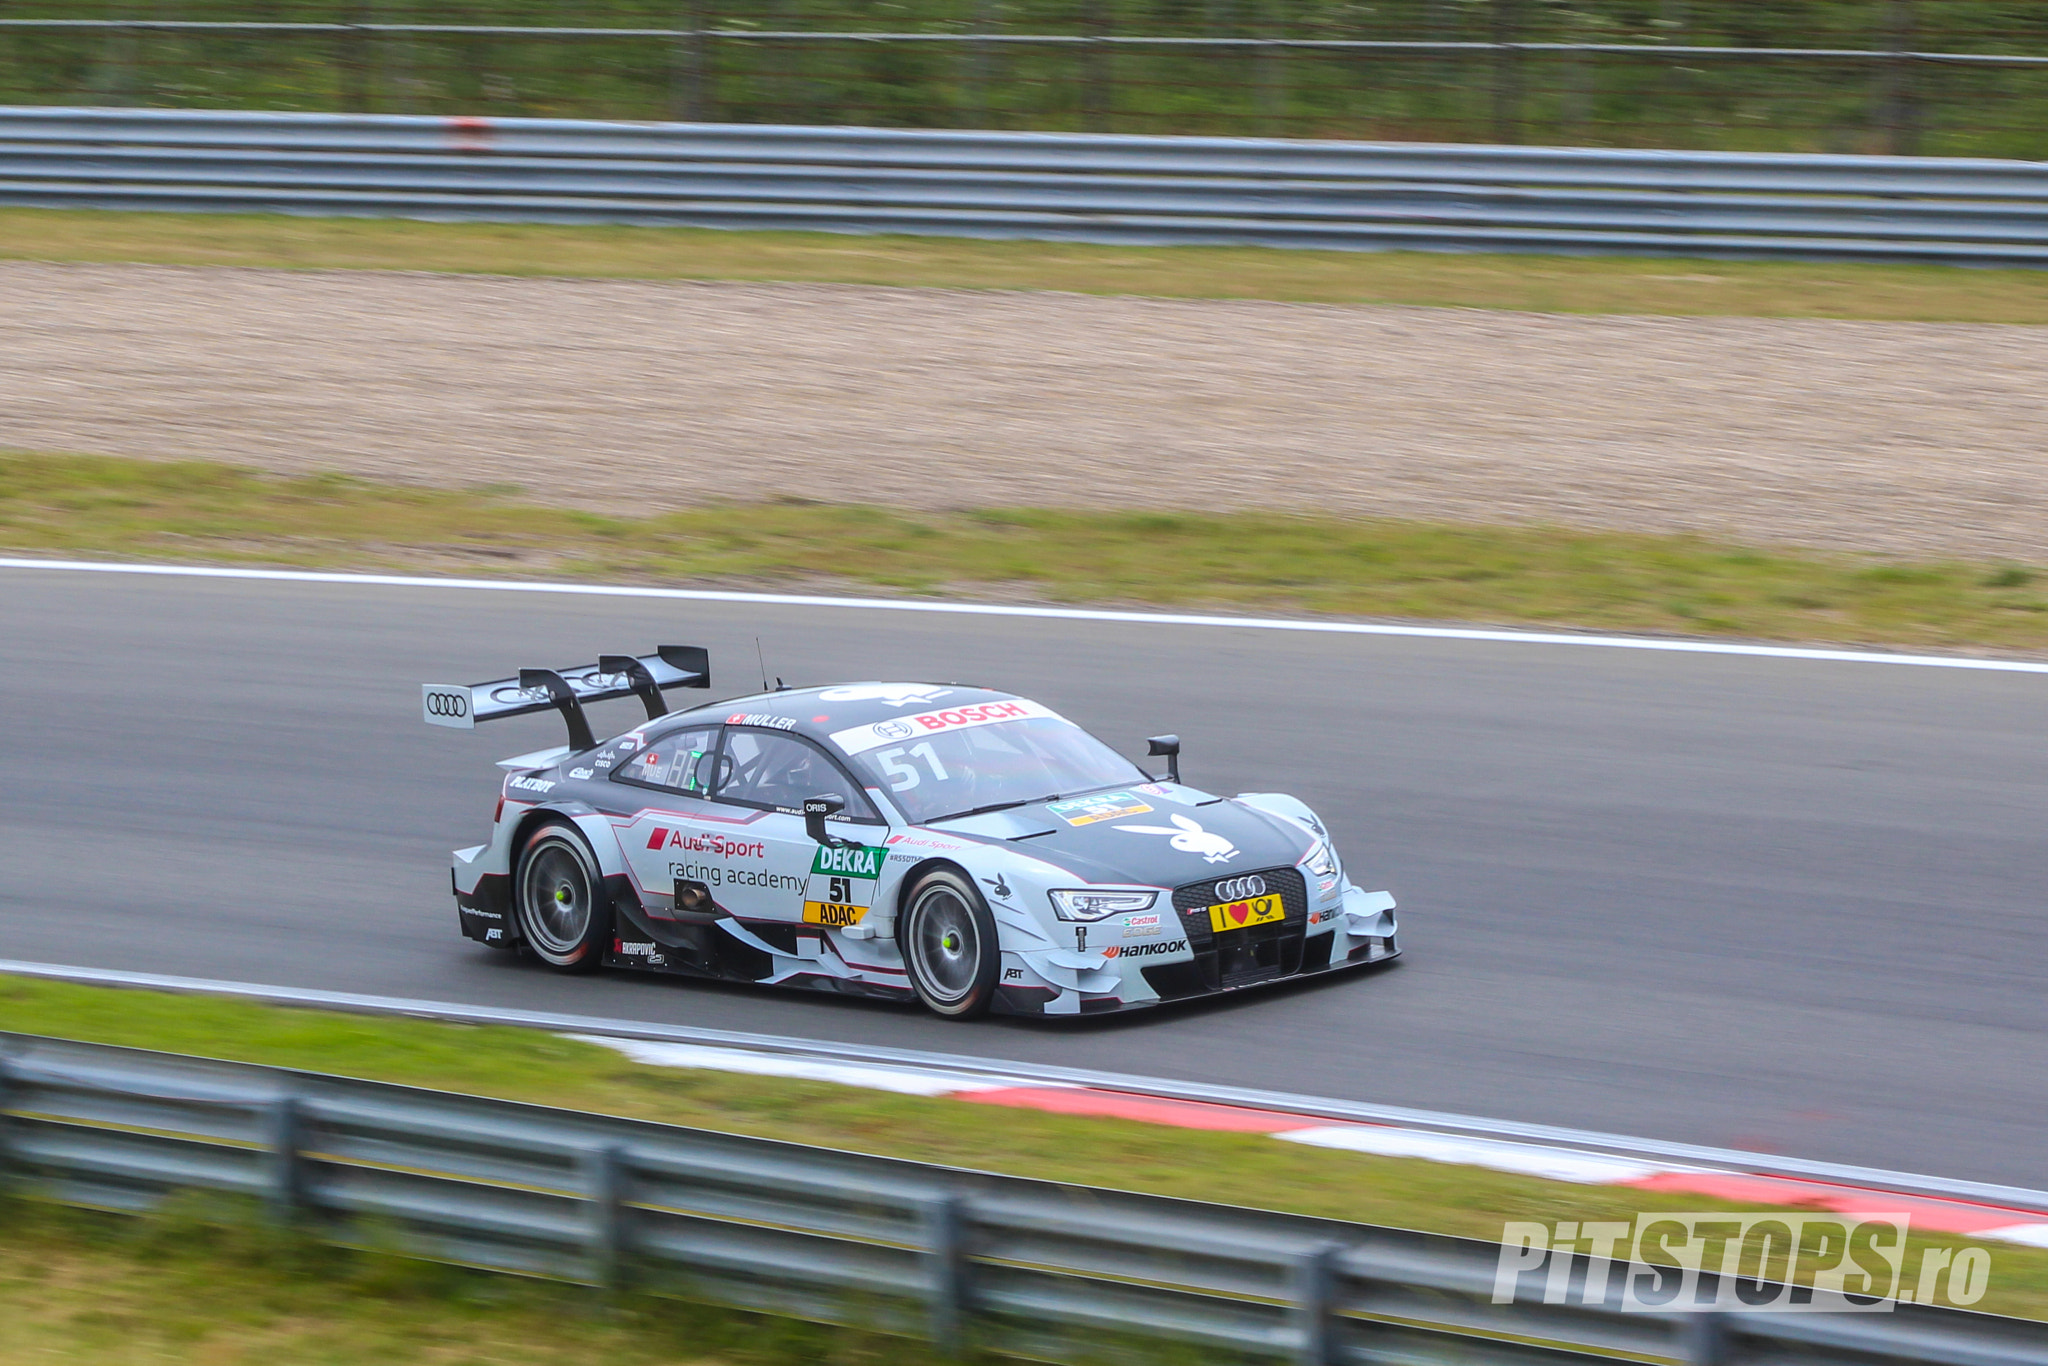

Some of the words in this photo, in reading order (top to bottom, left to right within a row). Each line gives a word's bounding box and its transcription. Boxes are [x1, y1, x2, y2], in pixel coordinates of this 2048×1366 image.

[914, 703, 1029, 730] BOSCH
[875, 742, 949, 792] 51
[509, 775, 556, 793] PLAYBOY
[806, 803, 827, 812] ORIS
[669, 830, 711, 852] Audi
[714, 835, 765, 859] Sport
[820, 847, 877, 875] DEKRA
[668, 860, 721, 887] racing
[727, 868, 808, 896] academy
[829, 877, 852, 903] 51
[820, 903, 858, 925] ADAC
[1131, 915, 1158, 926] Castrol
[1219, 906, 1227, 928] I
[486, 928, 502, 940] ABT
[1122, 926, 1162, 938] EDGE
[1004, 968, 1024, 980] ABT
